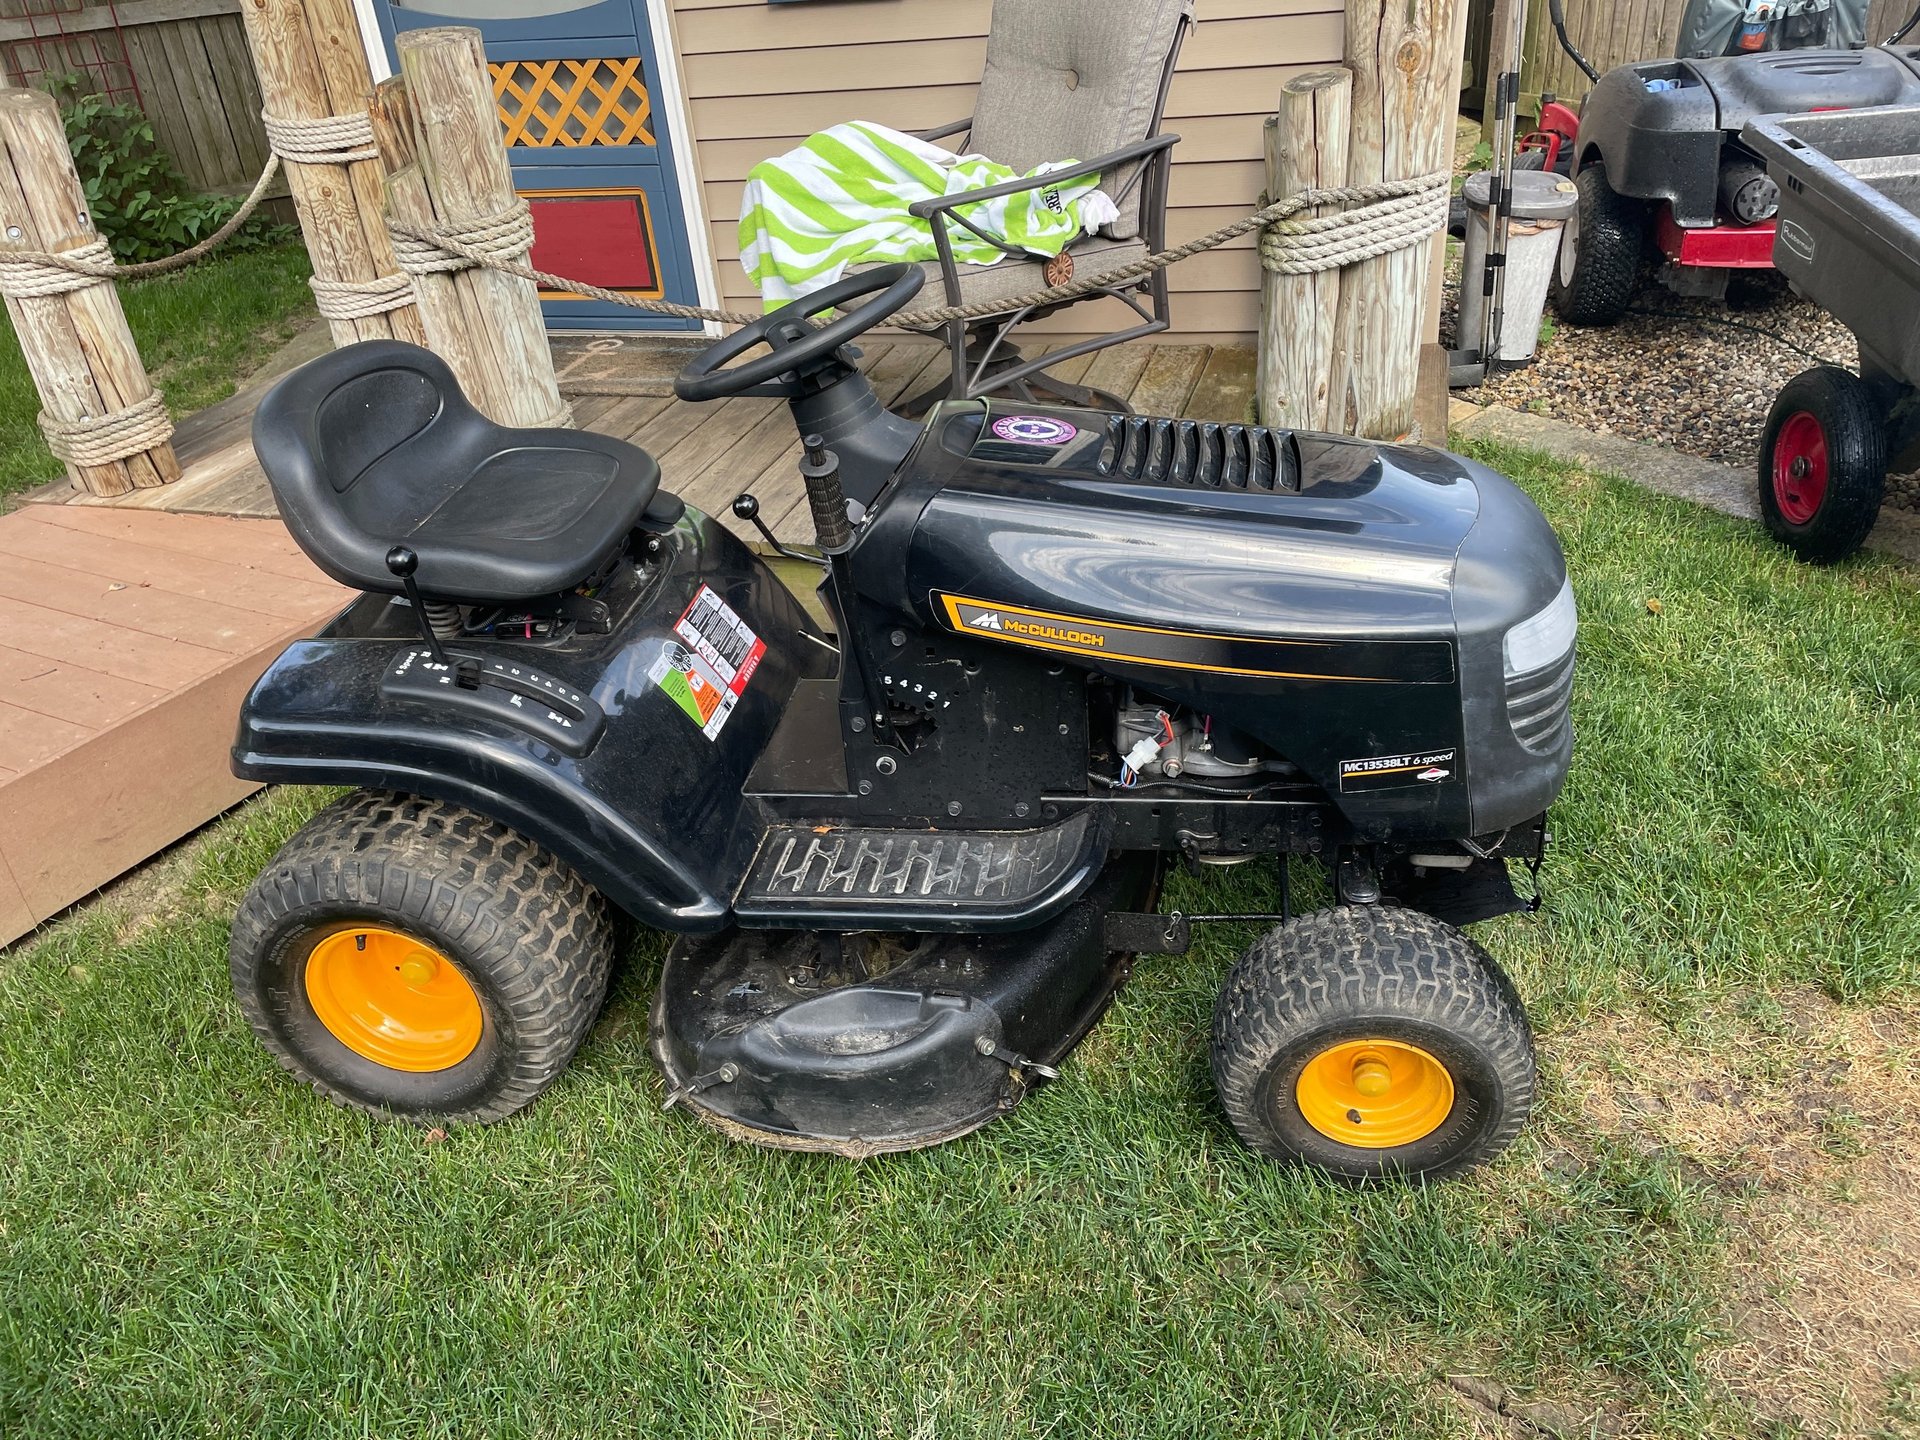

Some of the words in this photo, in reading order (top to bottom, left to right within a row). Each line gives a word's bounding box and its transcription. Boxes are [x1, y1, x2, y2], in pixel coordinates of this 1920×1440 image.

[1783, 225, 1813, 253] Rubbermaid
[1004, 619, 1104, 647] McCULLOCH
[530, 674, 539, 682] 3
[558, 687, 566, 695] 5
[571, 694, 580, 702] 6
[884, 675, 893, 685] 5
[900, 679, 908, 688] 4
[914, 684, 923, 693] 3
[928, 691, 938, 700] 2
[1344, 757, 1411, 772] MC13538LT
[1422, 752, 1453, 766] speed
